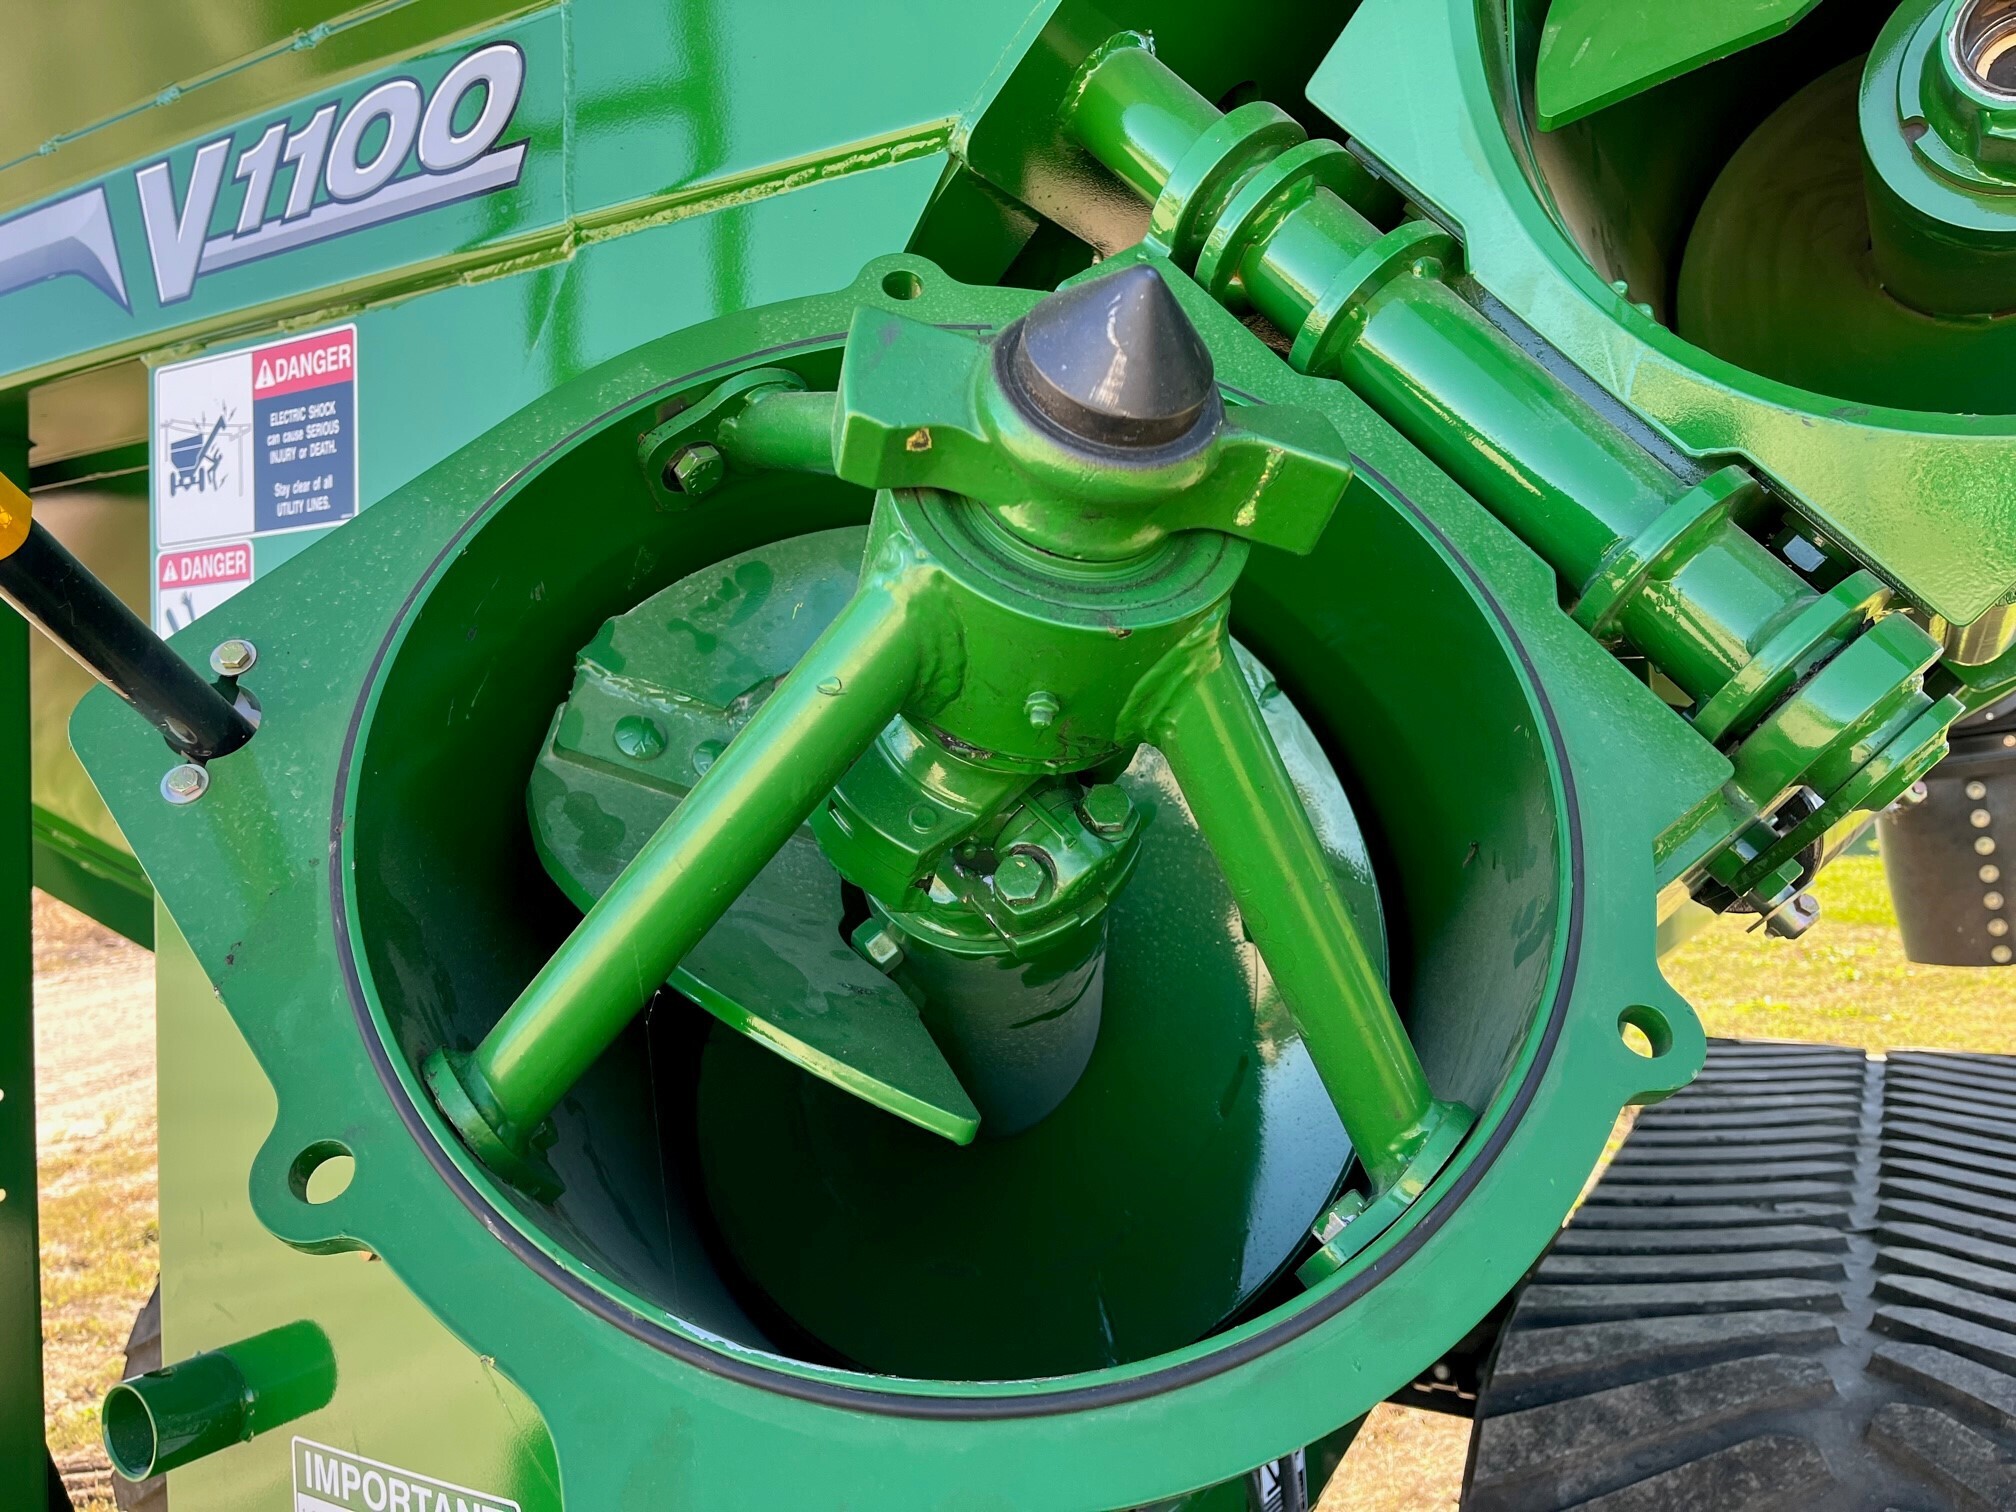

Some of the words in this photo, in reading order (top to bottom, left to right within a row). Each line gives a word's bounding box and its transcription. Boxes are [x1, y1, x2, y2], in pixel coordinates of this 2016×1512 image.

[136, 39, 526, 307] V1100
[275, 343, 351, 384] DANGER
[270, 406, 307, 427] ELECTRIC
[308, 400, 337, 420] SHOCK
[266, 433, 281, 447] can
[282, 429, 304, 444] cause
[305, 419, 340, 439] SERIOUS
[269, 446, 297, 465] INJURY
[299, 447, 308, 459] or
[309, 439, 338, 457] DEATH.
[274, 482, 291, 499] Stay
[292, 480, 311, 494] clear
[312, 475, 322, 491] of
[323, 474, 334, 490] all
[276, 499, 305, 517] UTILITY
[306, 495, 331, 513] LINES.
[181, 550, 247, 581] DANGER
[304, 1450, 503, 1512] IMPORTA
